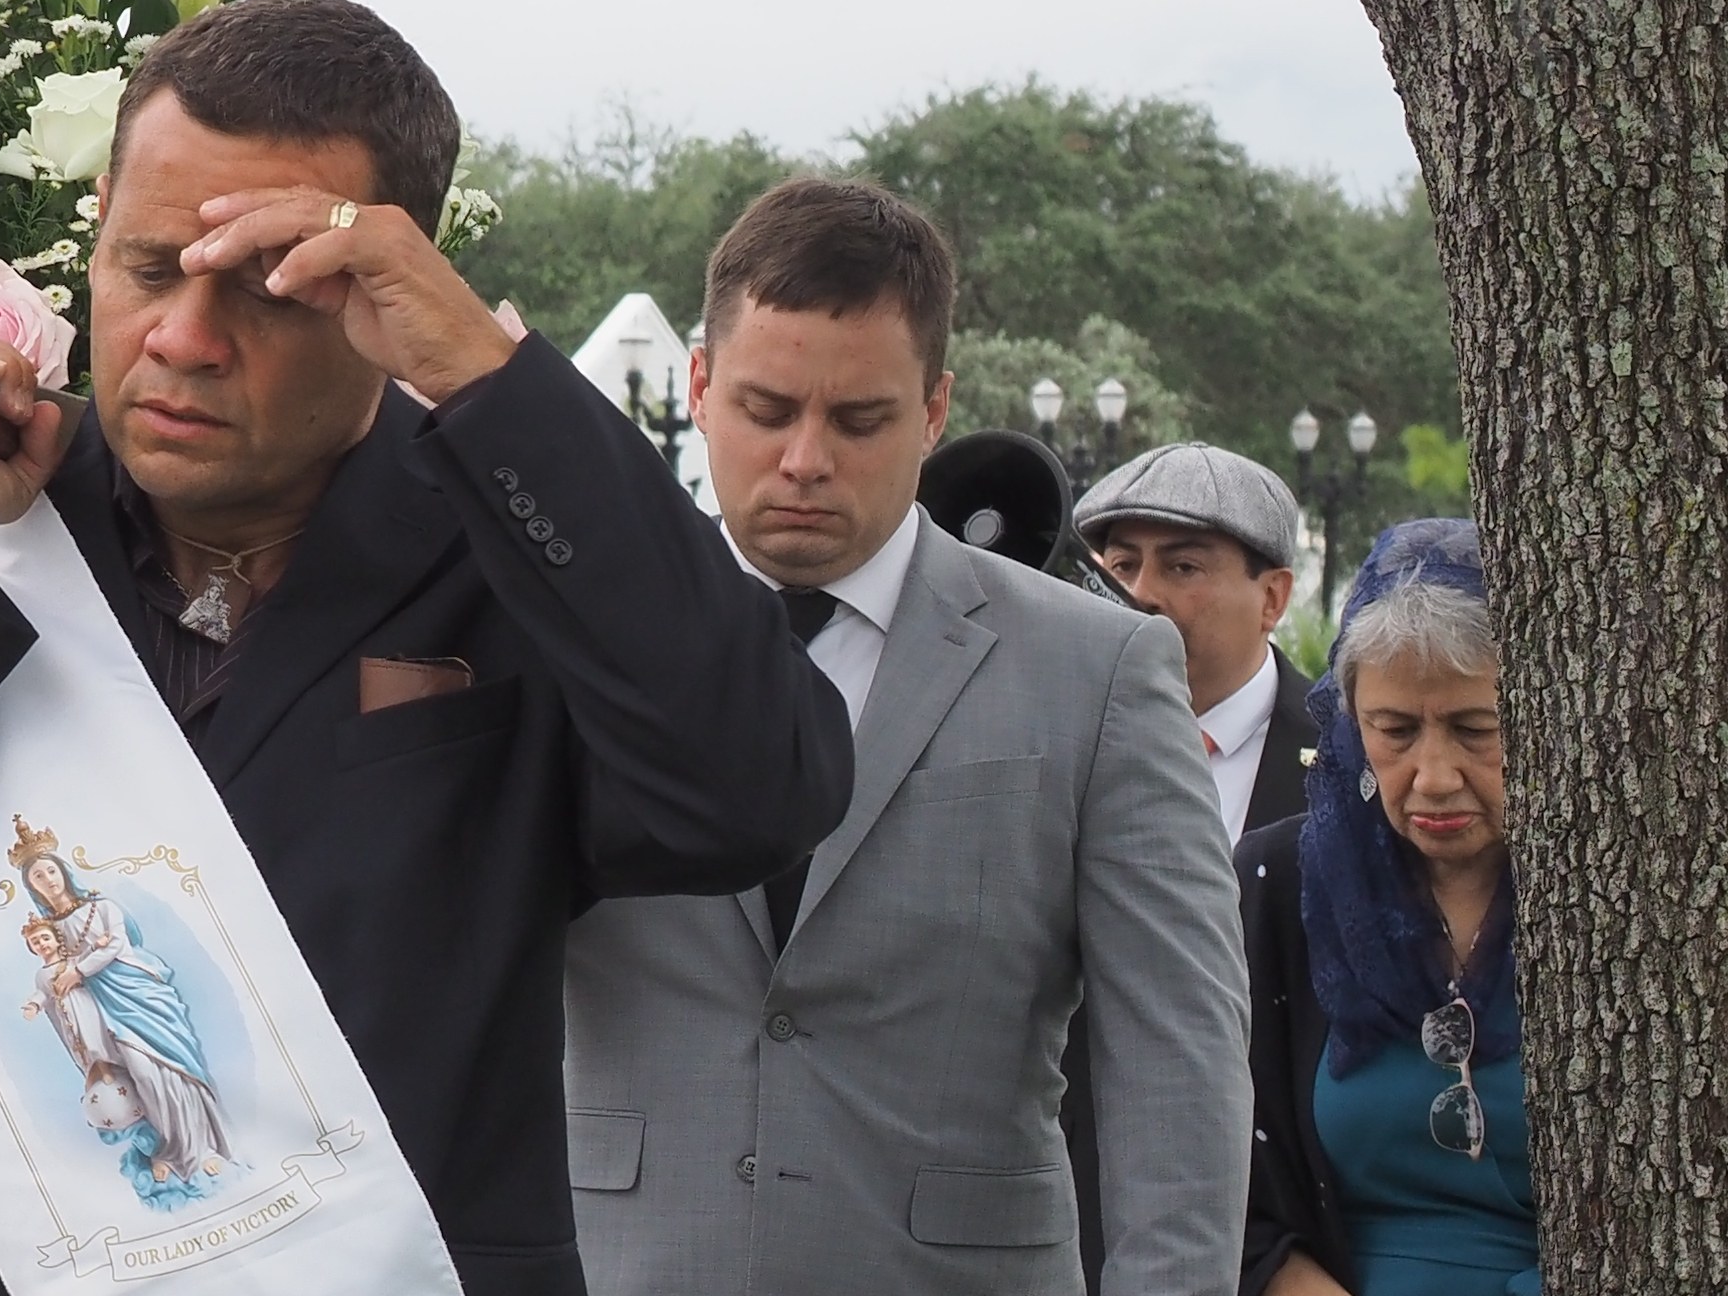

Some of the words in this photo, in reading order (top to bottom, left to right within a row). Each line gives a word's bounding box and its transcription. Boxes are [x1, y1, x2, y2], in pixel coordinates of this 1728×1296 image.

[124, 1247, 162, 1268] OUR
[163, 1235, 204, 1262] LADY
[207, 1226, 229, 1247] OF
[230, 1190, 301, 1236] VICTORY
